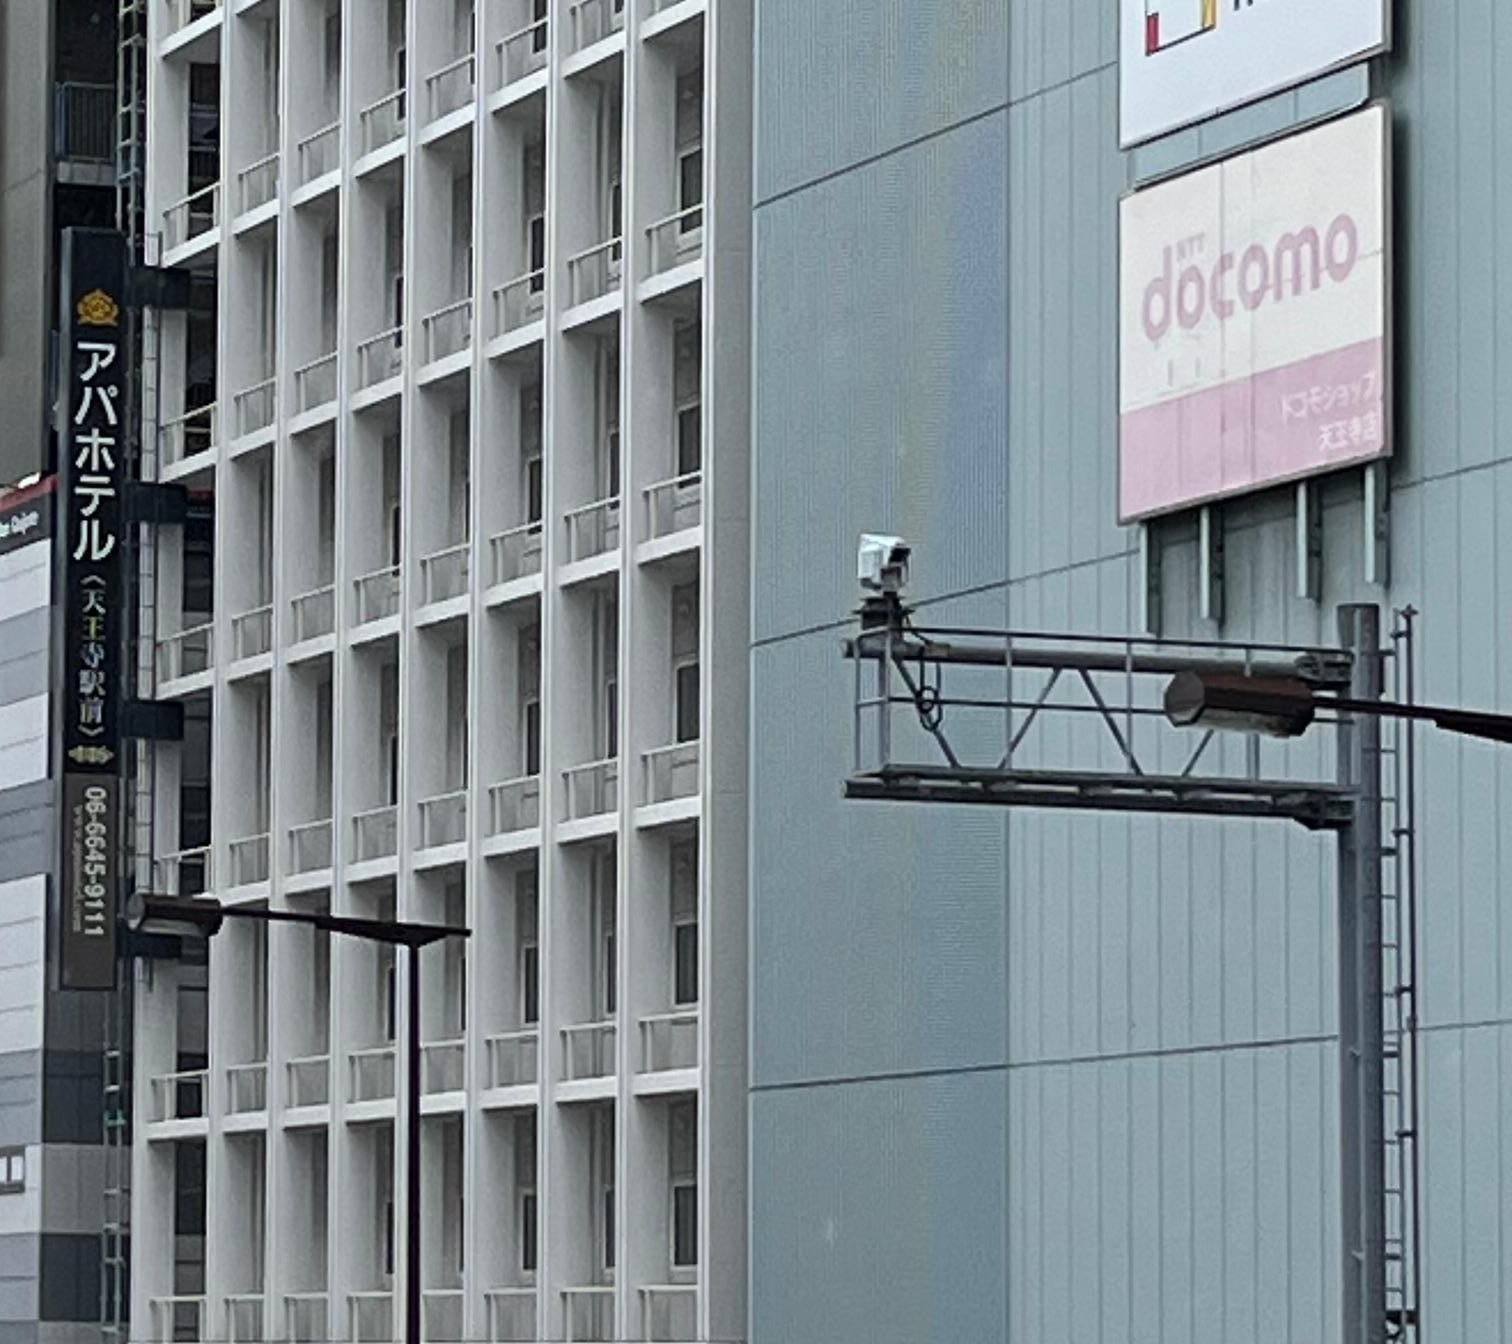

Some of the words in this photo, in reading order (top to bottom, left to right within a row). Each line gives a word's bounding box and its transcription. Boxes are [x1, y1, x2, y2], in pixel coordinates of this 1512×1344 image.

[1141, 212, 1358, 343] docomo
[73, 341, 119, 562] アパホテル
[84, 785, 108, 937] 06-6645-9111
